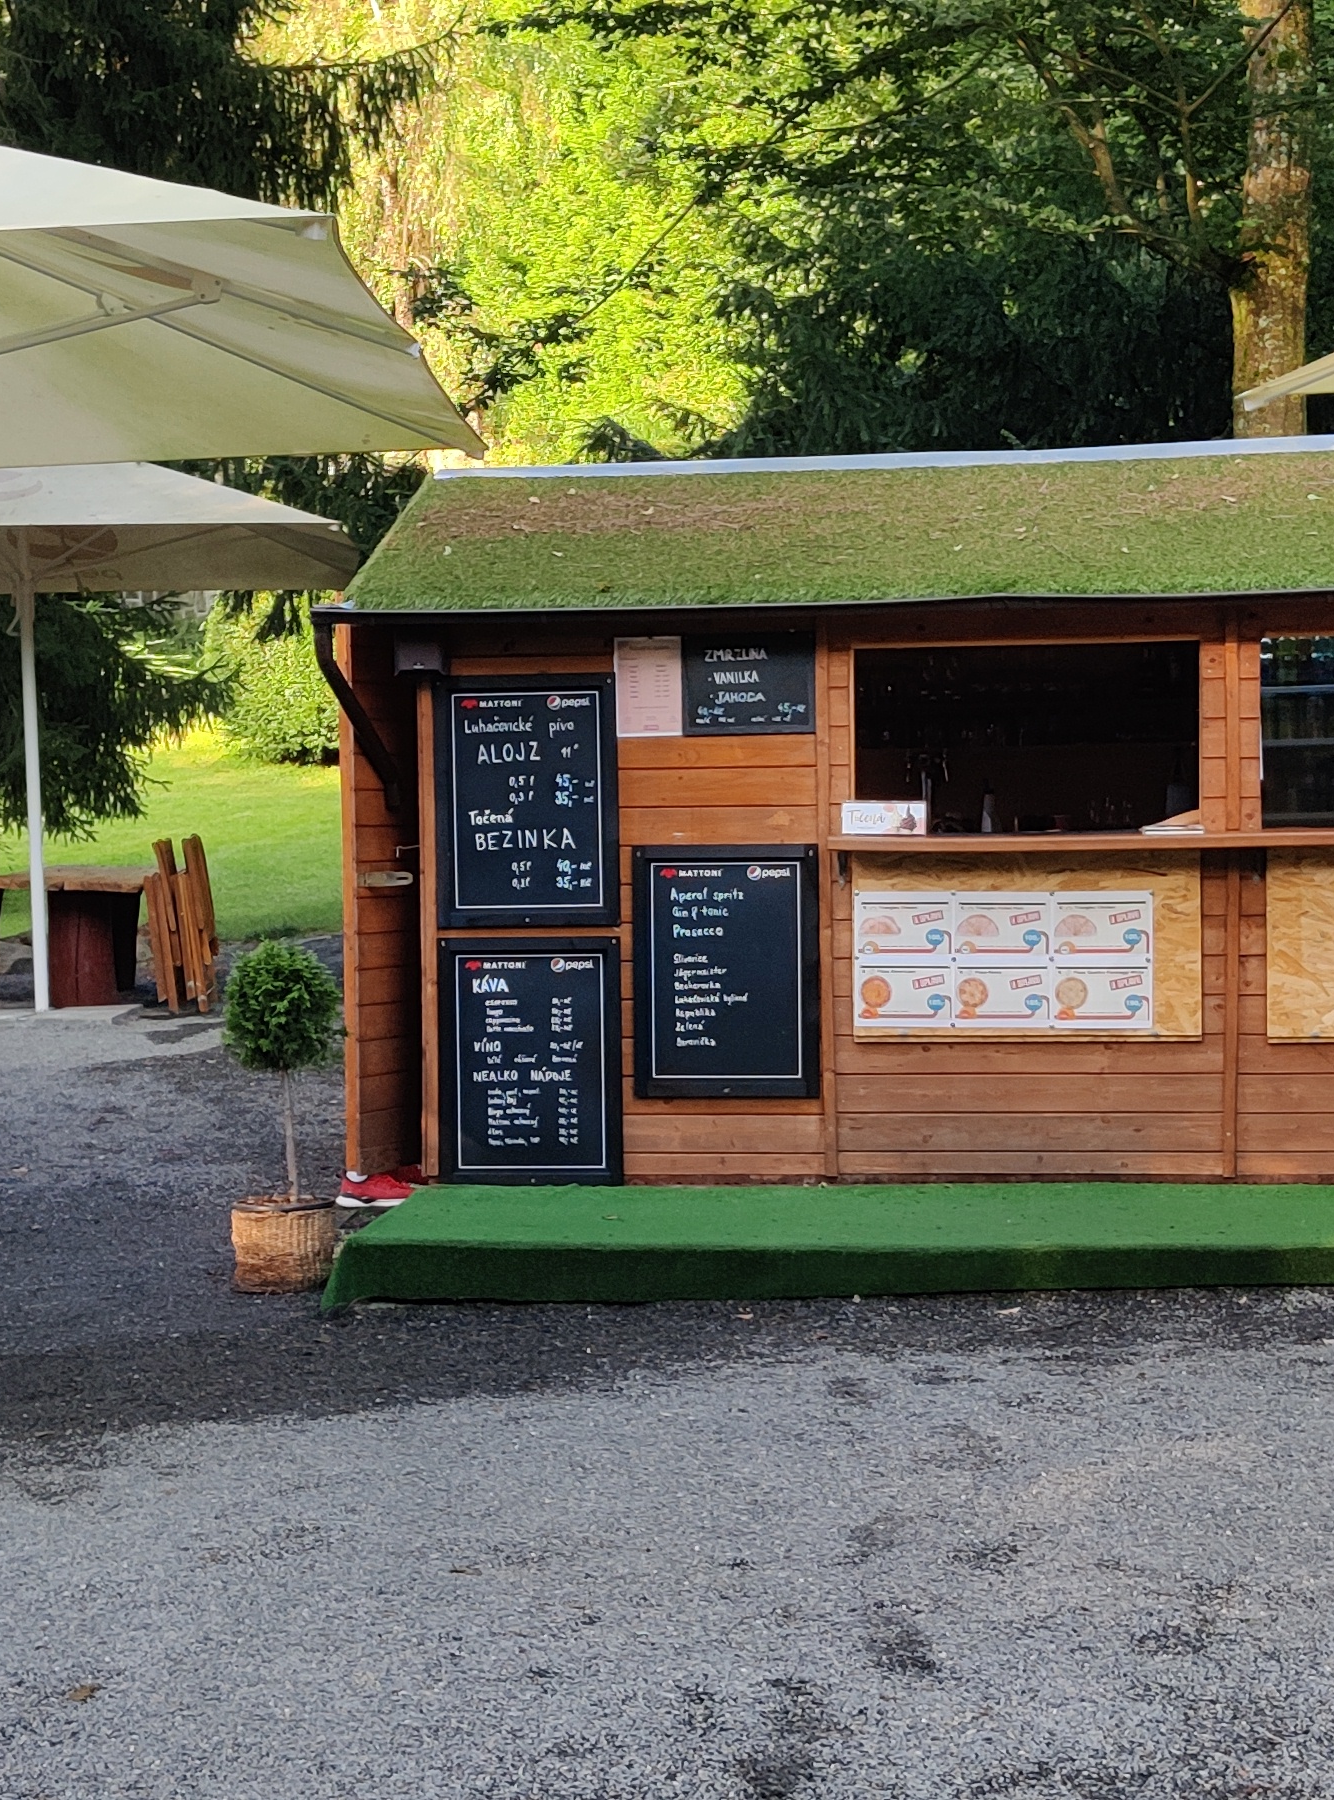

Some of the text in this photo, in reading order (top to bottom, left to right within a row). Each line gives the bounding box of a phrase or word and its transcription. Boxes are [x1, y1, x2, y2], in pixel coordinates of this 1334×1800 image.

[713, 669, 760, 685] VANILKA
[478, 698, 524, 708] MATTONI
[561, 696, 591, 708] pepsi
[714, 691, 767, 704] JAHODA
[548, 717, 575, 739] pivo
[477, 741, 541, 765] ALOJZ
[468, 807, 514, 826] Točená
[475, 827, 576, 851] BEZINKA
[678, 868, 724, 877] MATTONI
[761, 868, 791, 879] pepsi
[670, 886, 744, 904] Aperol spritz
[672, 906, 689, 918] Gin
[699, 905, 729, 917] tonic
[482, 960, 527, 969] MATTONI
[565, 959, 594, 971] pepsi
[472, 973, 509, 994] KÁVA
[473, 1036, 502, 1053] VÍNO
[472, 1066, 573, 1082] NEALKO NÁPOJE
